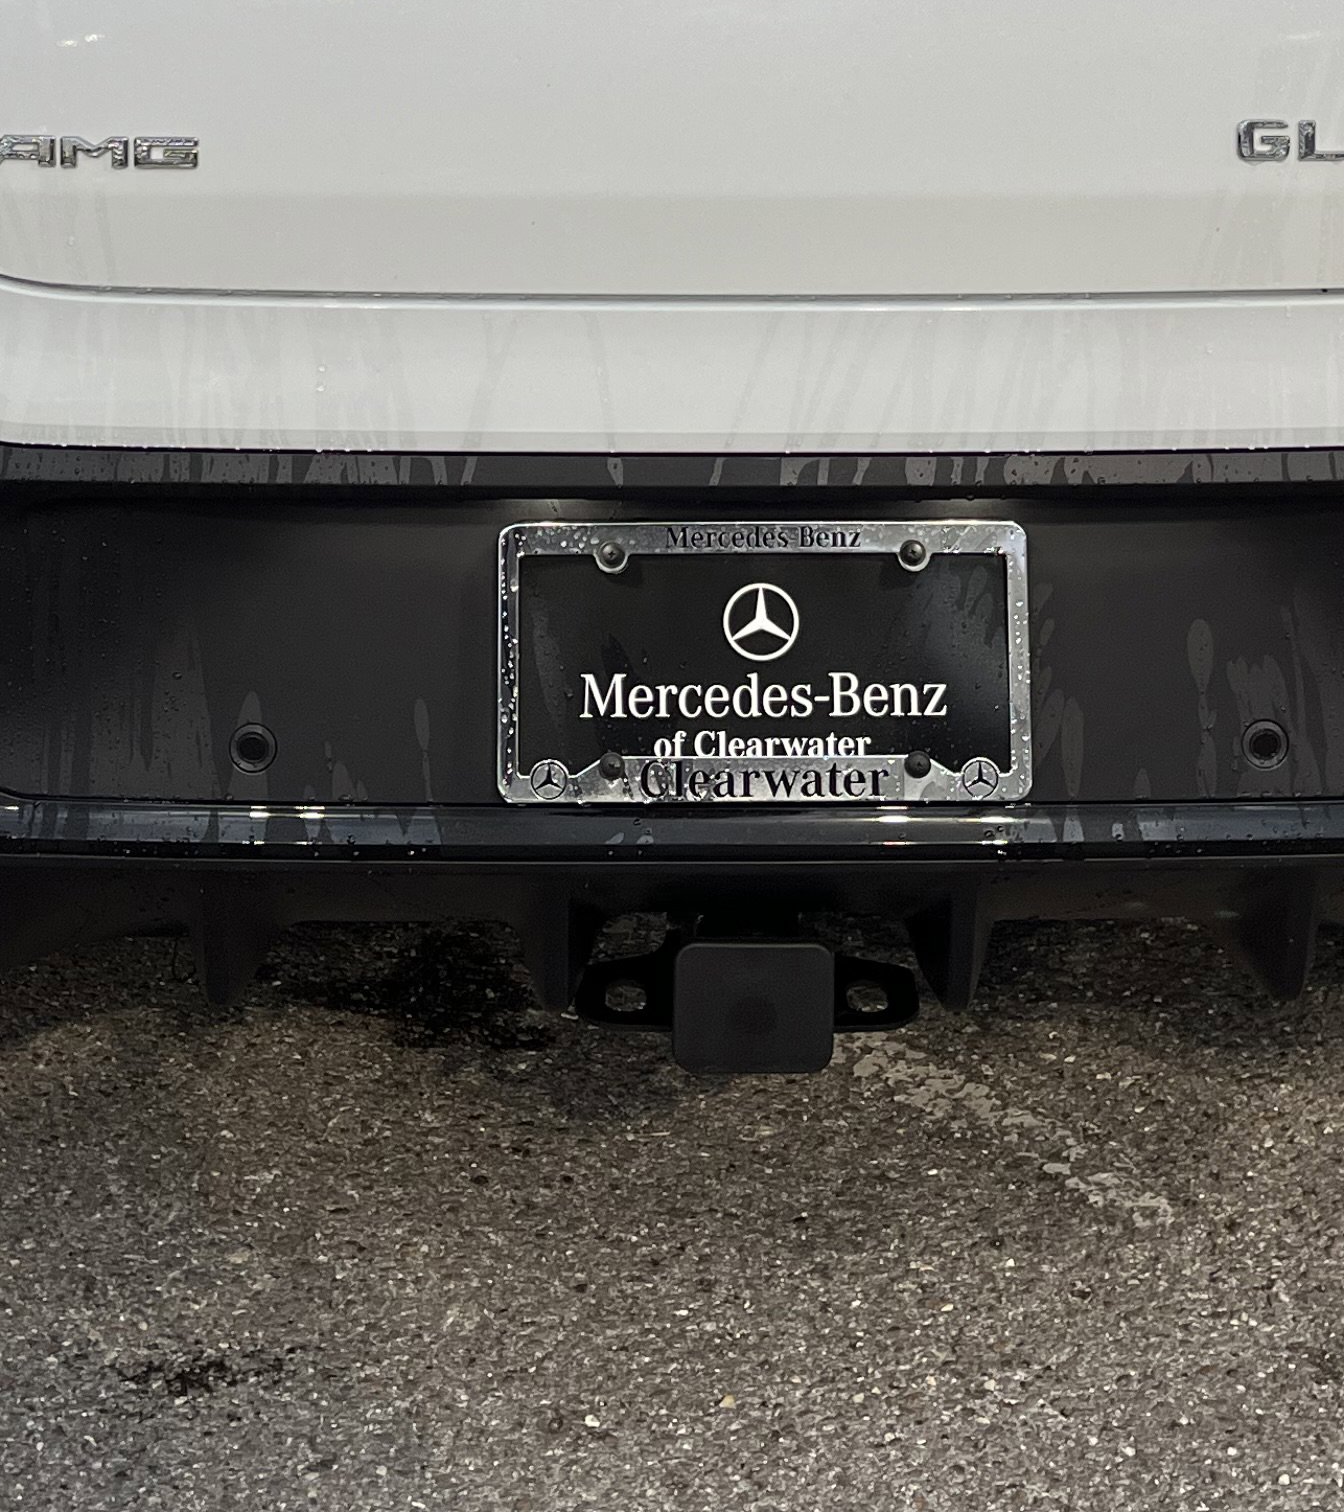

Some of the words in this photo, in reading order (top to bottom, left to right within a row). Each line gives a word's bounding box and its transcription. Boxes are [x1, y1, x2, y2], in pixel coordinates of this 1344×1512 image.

[579, 671, 948, 719] Mercedes-Benz
[654, 731, 687, 758] of
[694, 731, 871, 757] Clearwater
[640, 760, 889, 799] Clearwater
